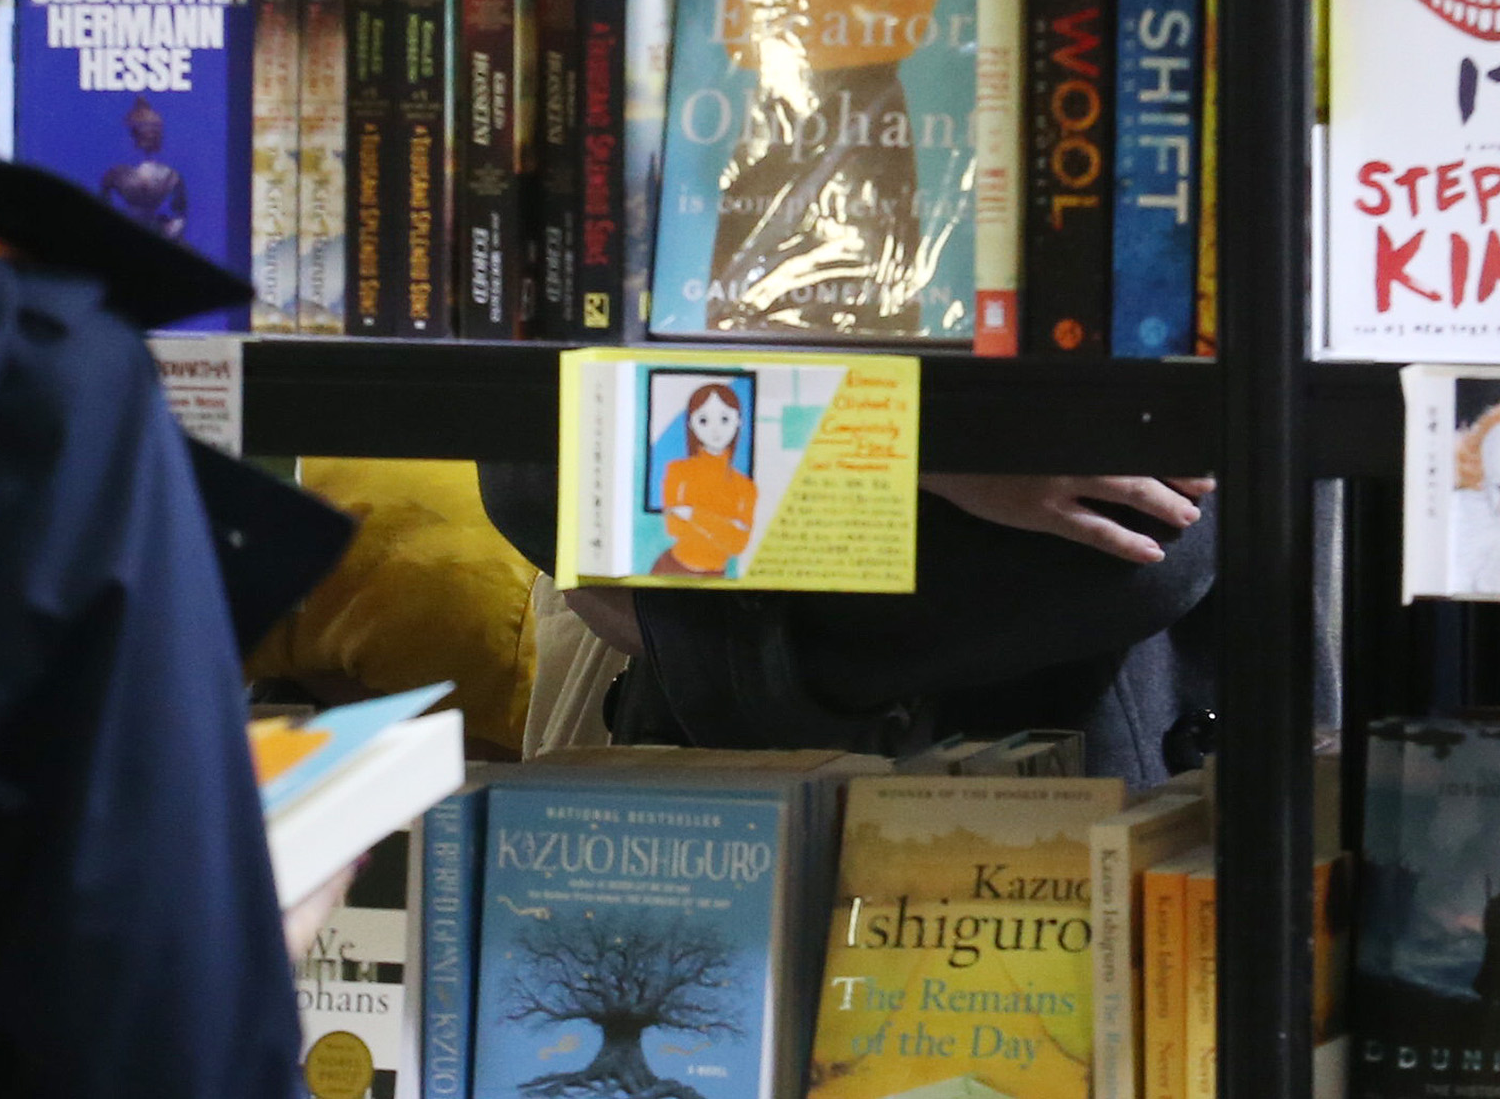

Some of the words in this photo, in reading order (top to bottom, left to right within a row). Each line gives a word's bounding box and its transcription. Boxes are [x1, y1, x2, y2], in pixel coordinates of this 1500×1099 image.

[48, 3, 225, 49] HERMANN
[80, 48, 193, 92] HESSE
[681, 86, 977, 164] Olphan
[1052, 6, 1102, 229] WOOL
[1136, 7, 1194, 224] SHIFT
[1352, 158, 1500, 227] STEP
[682, 277, 758, 300] GAI
[497, 827, 614, 874] KAZUO
[618, 832, 771, 884] ISHIGURO
[844, 895, 1092, 969] Ishiguro
[830, 974, 907, 1012] The
[919, 976, 1077, 1017] Remains
[850, 1023, 895, 1060] of
[899, 1020, 957, 1058] the
[968, 1023, 1039, 1075] Day
